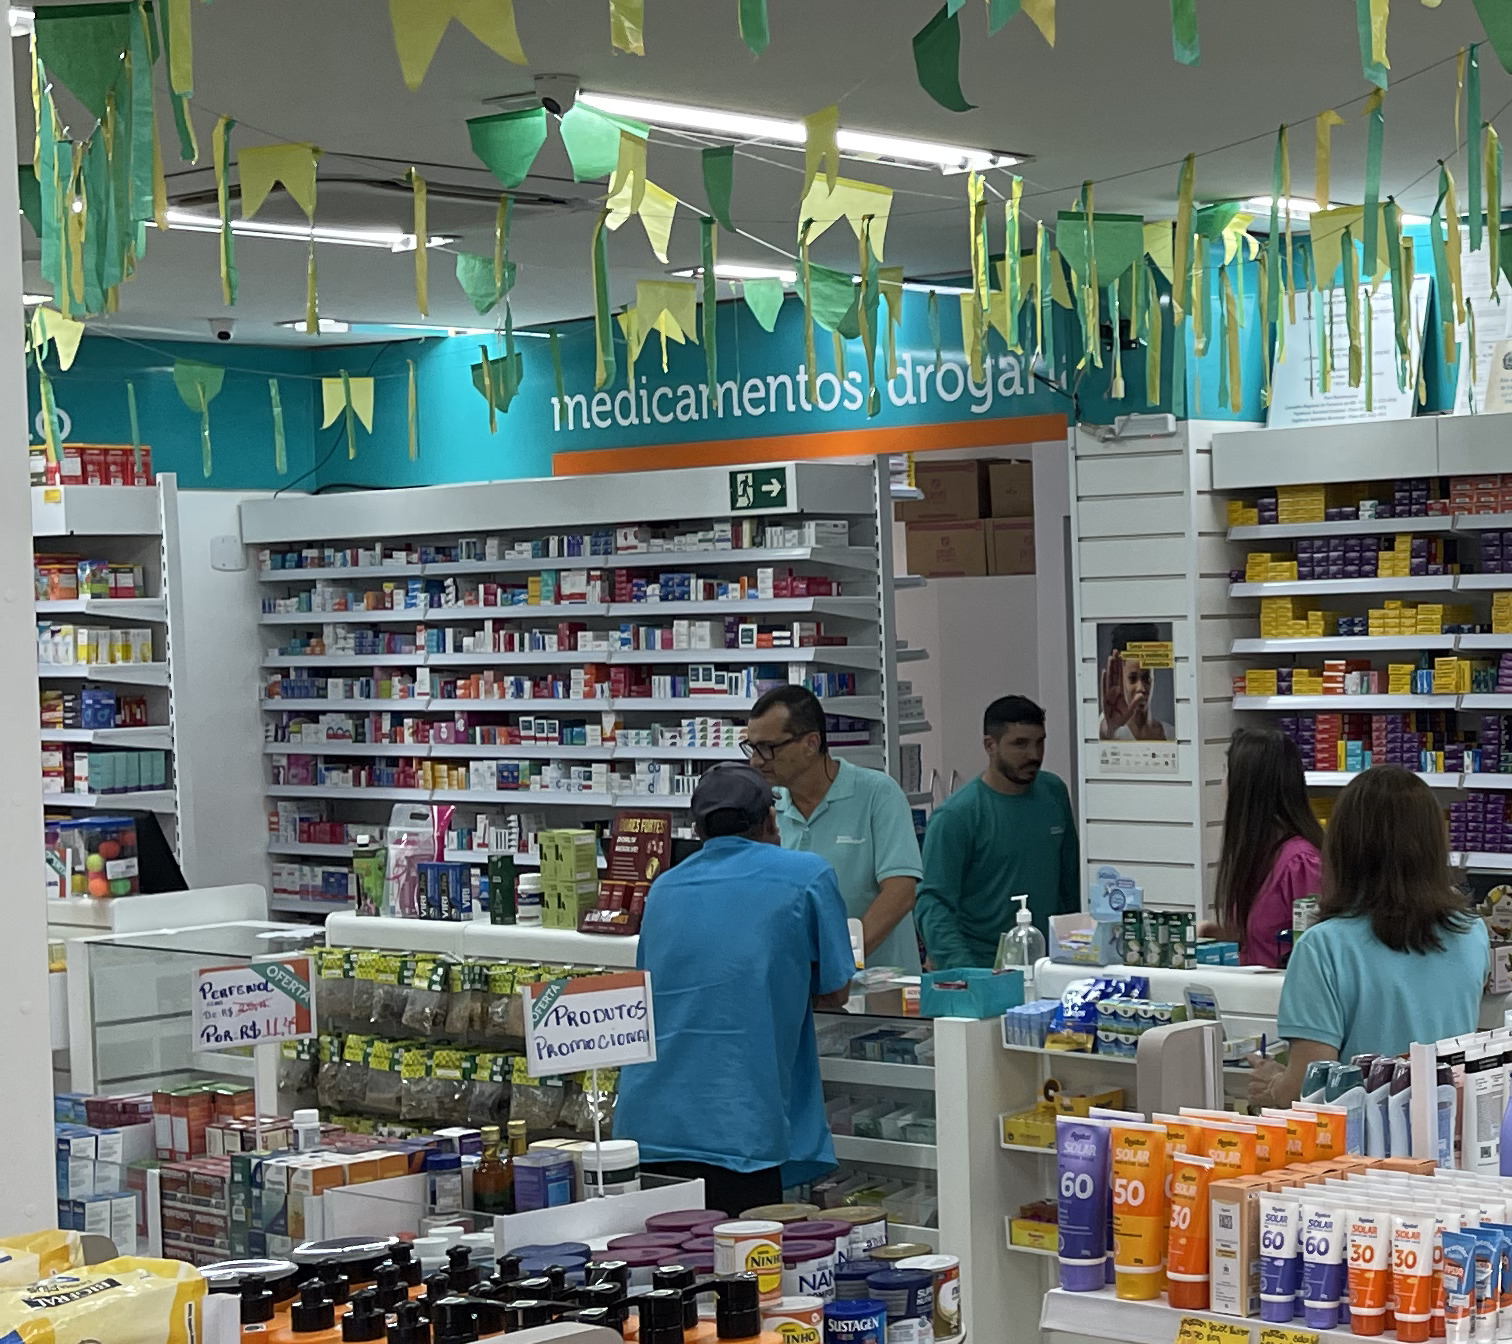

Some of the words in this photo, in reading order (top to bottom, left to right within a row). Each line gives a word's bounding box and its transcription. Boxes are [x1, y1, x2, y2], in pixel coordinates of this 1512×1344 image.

[550, 364, 863, 432] medicamentos
[266, 965, 310, 1003] OFERTA
[532, 983, 561, 1022] OFERTA
[543, 1000, 648, 1028] PRODUTOS
[1064, 1142, 1097, 1157] SOLAR
[1115, 1148, 1150, 1164] SOLAR
[1061, 1171, 1094, 1199] 60
[1114, 1179, 1145, 1206] 50
[1170, 1206, 1191, 1230] 30
[1265, 1213, 1288, 1224] SOLAR
[1308, 1219, 1333, 1230] SOLAR
[1262, 1230, 1285, 1251] 60
[1351, 1245, 1375, 1264] 30
[828, 1316, 880, 1333] SUSTAGEN
